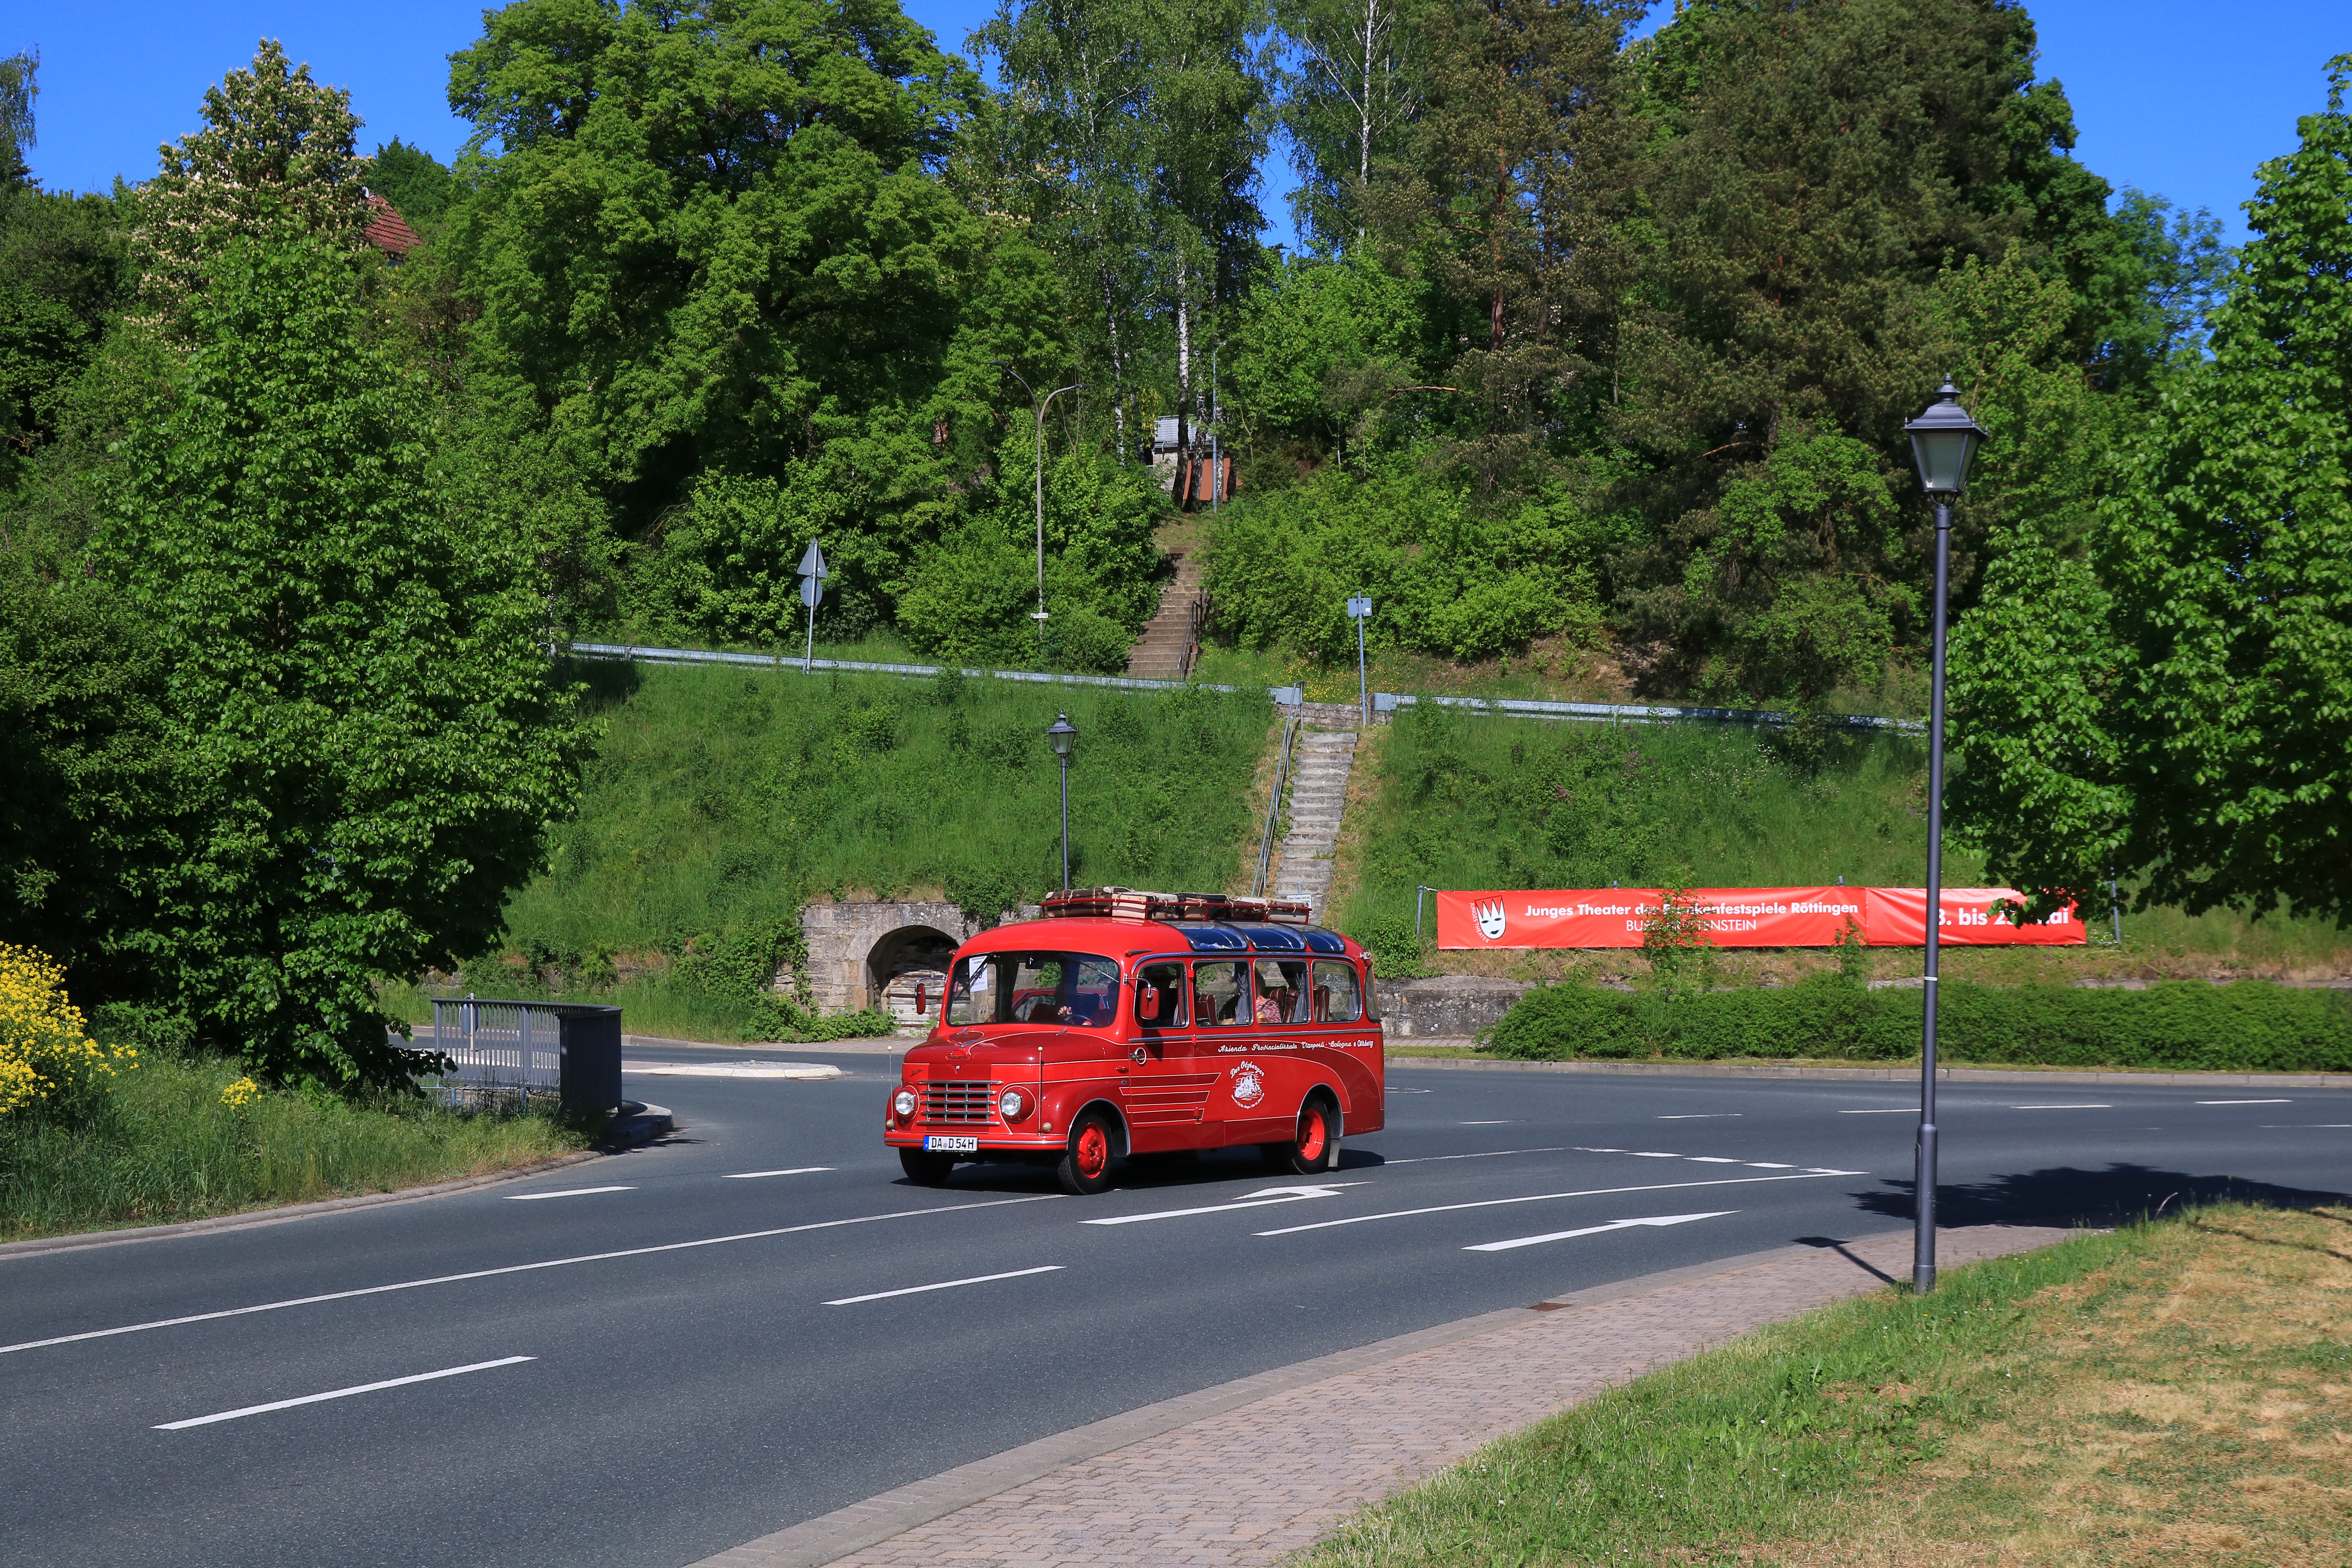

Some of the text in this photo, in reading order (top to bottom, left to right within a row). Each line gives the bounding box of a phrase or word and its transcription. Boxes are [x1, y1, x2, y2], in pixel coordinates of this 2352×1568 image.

[1525, 905, 1573, 918] Junges
[1577, 904, 1631, 915] Theater
[1791, 902, 1858, 915] Röttingen
[1959, 907, 1988, 926] bis
[2037, 907, 2069, 924] ai
[1470, 902, 1489, 943] JUNGES THEATER
[1328, 1040, 1352, 1049] Bologna
[1230, 1061, 1265, 1079] Der Otzberger
[931, 1138, 942, 1148] DA
